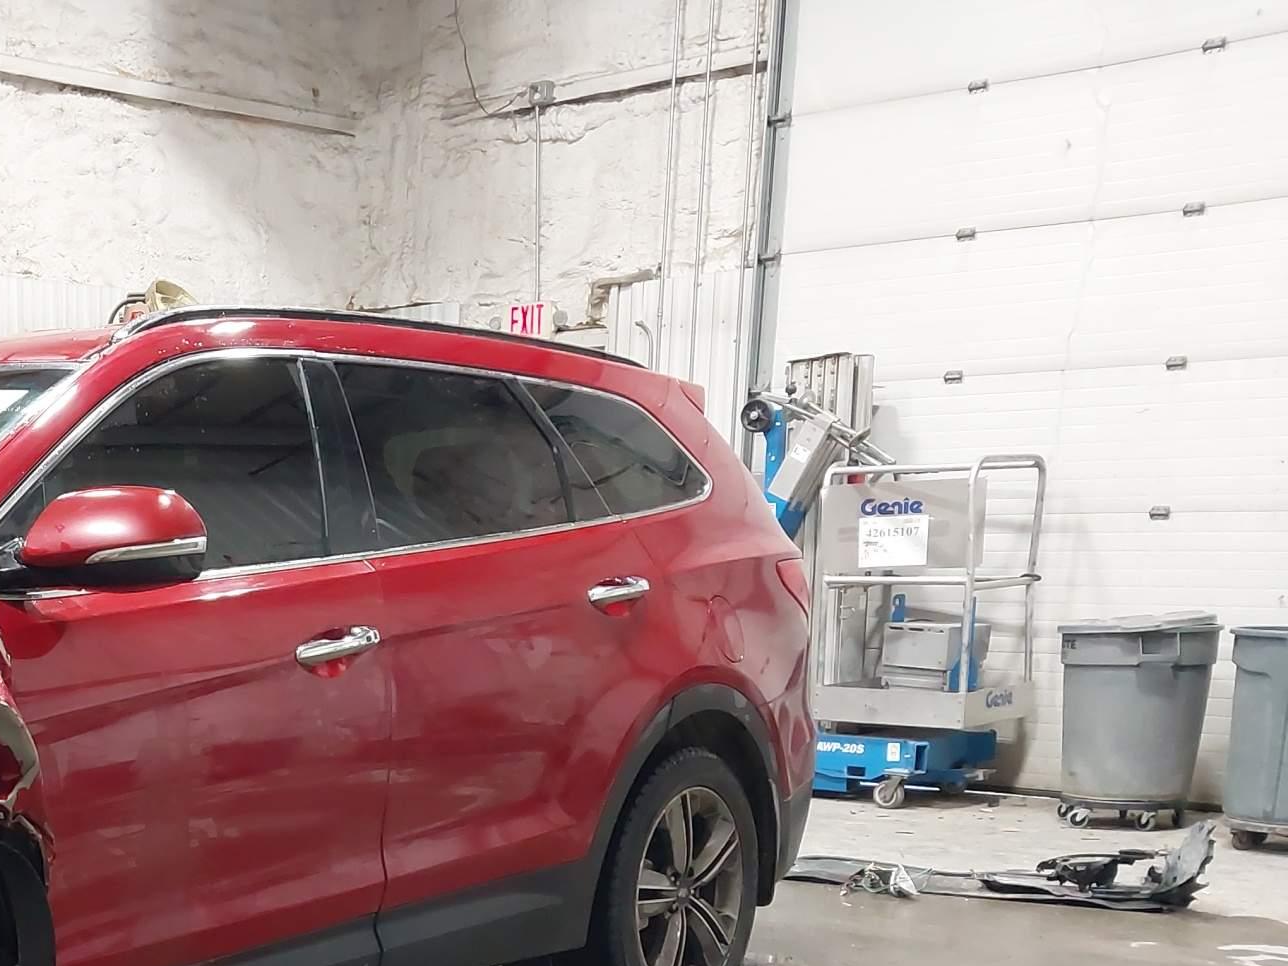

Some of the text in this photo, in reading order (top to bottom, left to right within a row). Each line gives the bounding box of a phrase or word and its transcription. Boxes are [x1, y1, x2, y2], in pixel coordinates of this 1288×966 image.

[511, 304, 544, 334] EXIT
[861, 497, 923, 515] Genie
[865, 526, 921, 538] 42615107
[816, 741, 865, 754] AWP-20S
